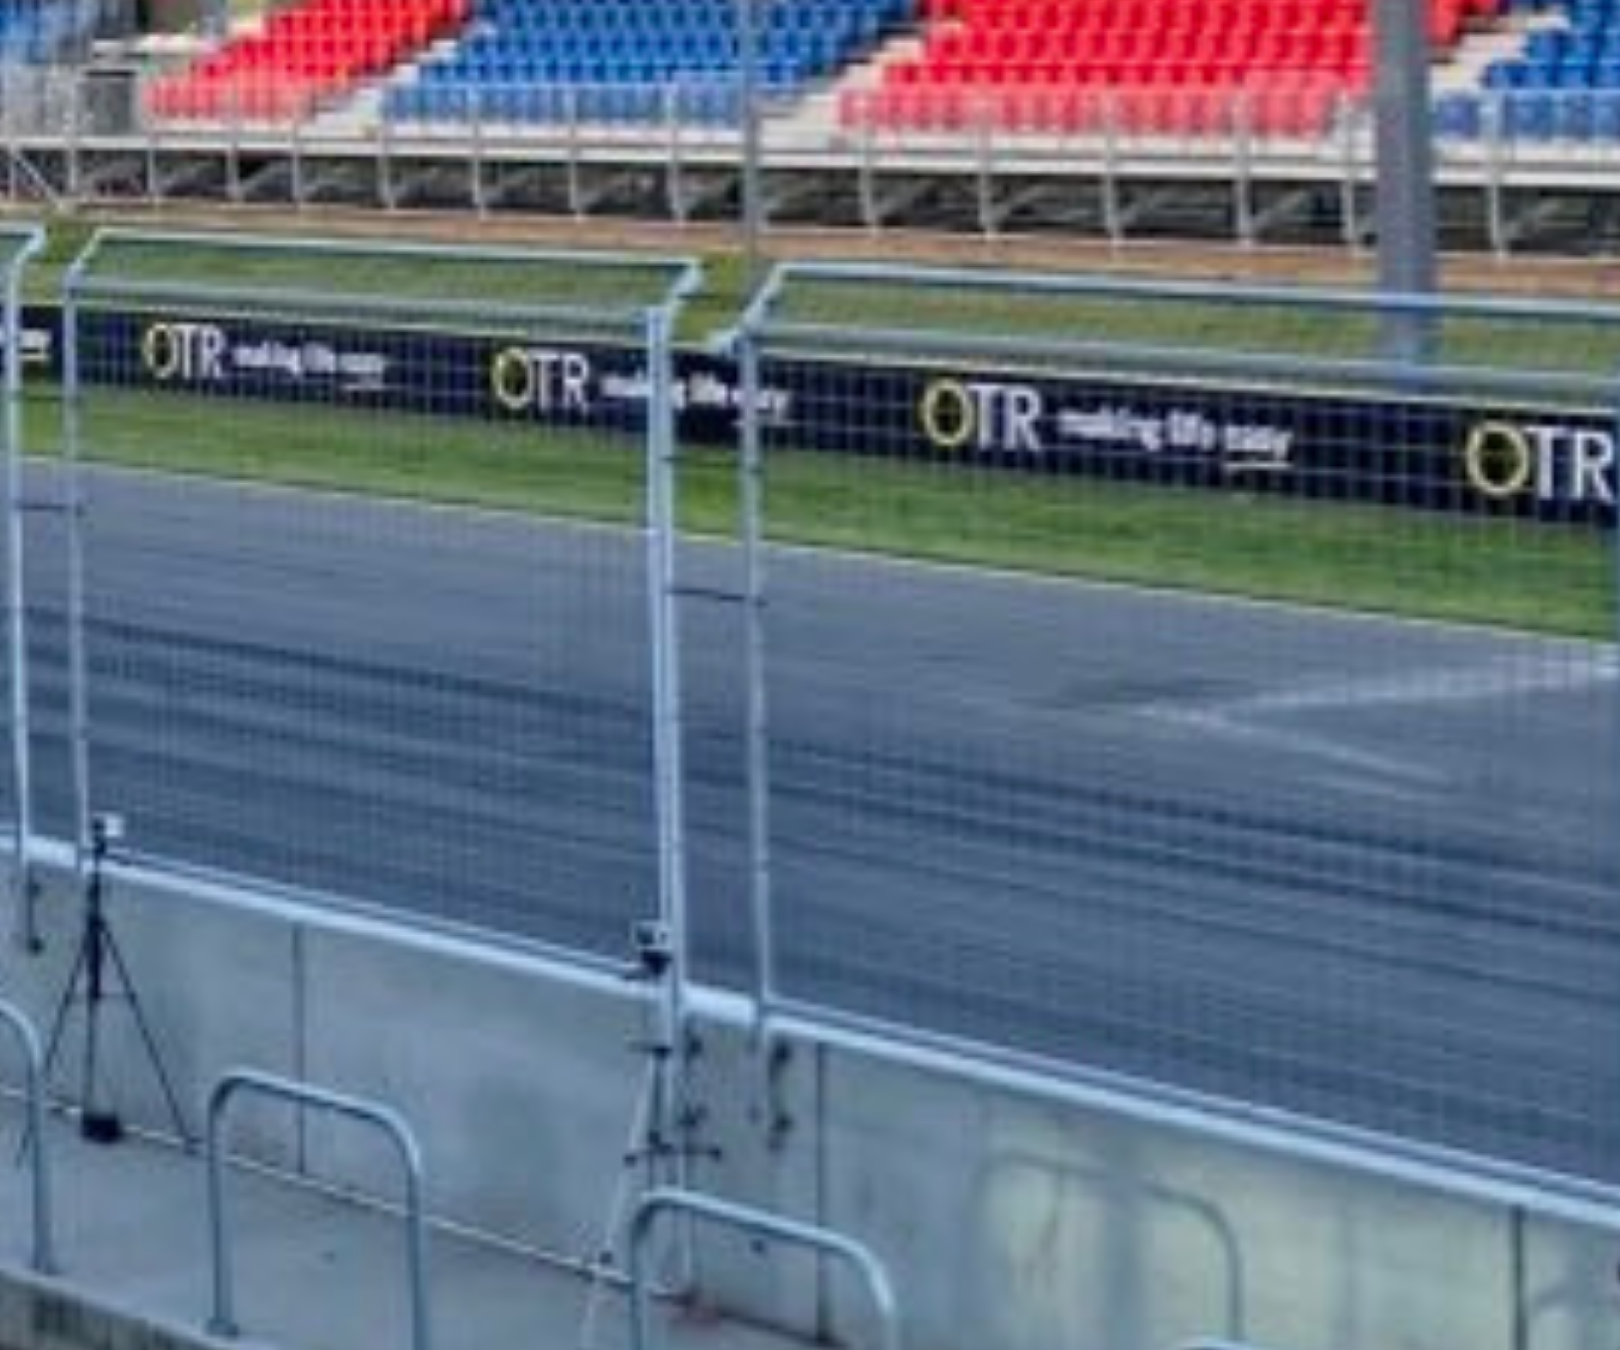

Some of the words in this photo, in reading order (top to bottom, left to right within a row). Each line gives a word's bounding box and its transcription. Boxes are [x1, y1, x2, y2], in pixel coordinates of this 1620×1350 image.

[144, 321, 225, 380] OTR
[491, 347, 590, 413] OTR
[920, 377, 1044, 453] OTR
[1465, 420, 1617, 505] OTR
